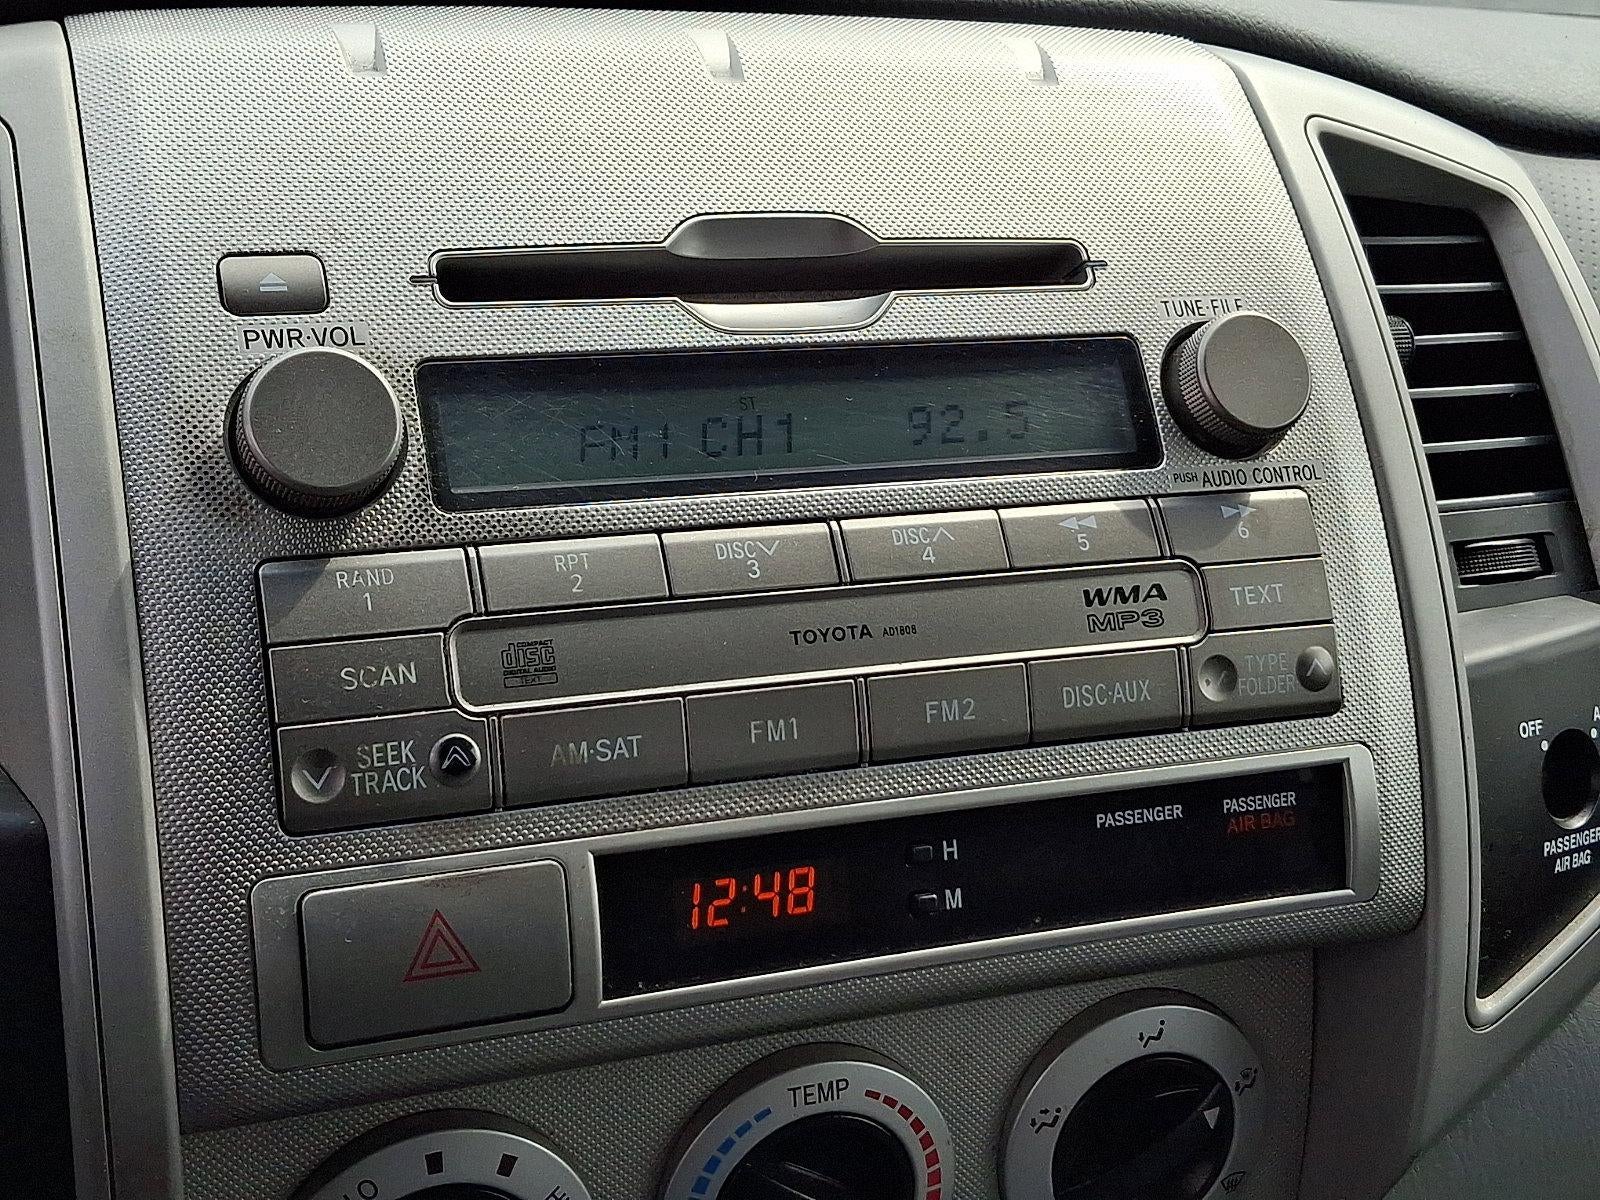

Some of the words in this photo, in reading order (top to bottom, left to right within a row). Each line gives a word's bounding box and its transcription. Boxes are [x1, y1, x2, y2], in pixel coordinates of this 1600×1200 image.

[739, 396, 757, 410] ST
[701, 412, 793, 457] CH1
[908, 400, 1029, 446] 92.5
[1173, 471, 1198, 483] PUSH
[1202, 468, 1247, 488] AUDIO
[1252, 464, 1322, 484] CONTROL
[891, 527, 930, 545] DISC
[1237, 521, 1249, 539] 6
[714, 541, 757, 560] DISC
[1077, 533, 1090, 551] 5
[554, 552, 590, 572] RPT
[921, 546, 936, 564] 4
[335, 567, 394, 589] RAND
[746, 560, 761, 579] 3
[571, 573, 584, 593] 2
[1229, 583, 1283, 606] TEXT
[362, 592, 373, 611] 1
[1082, 583, 1168, 608] WMA
[1086, 608, 1165, 633] MP3
[789, 624, 873, 645] TOYOTA
[882, 624, 917, 637] AD1808
[1244, 652, 1288, 672] TYPE
[339, 661, 417, 690] SCAN
[519, 676, 541, 684] TEXT
[1238, 674, 1295, 696] FOLDER
[925, 697, 976, 723] FM2
[749, 717, 799, 744] FM1
[1518, 718, 1544, 739] OFF
[356, 739, 416, 769] SEEK
[350, 765, 427, 797] TRACK
[1223, 791, 1297, 814] PASSENGER
[1096, 804, 1184, 829] PASSENGER
[1227, 814, 1256, 833] AIR
[1260, 810, 1297, 830] BAG
[942, 838, 959, 861] H
[1554, 855, 1571, 874] AIR
[1572, 849, 1592, 868] BAG
[689, 866, 816, 930] 12:48
[944, 887, 963, 910] M
[786, 1077, 850, 1108] TEMP
